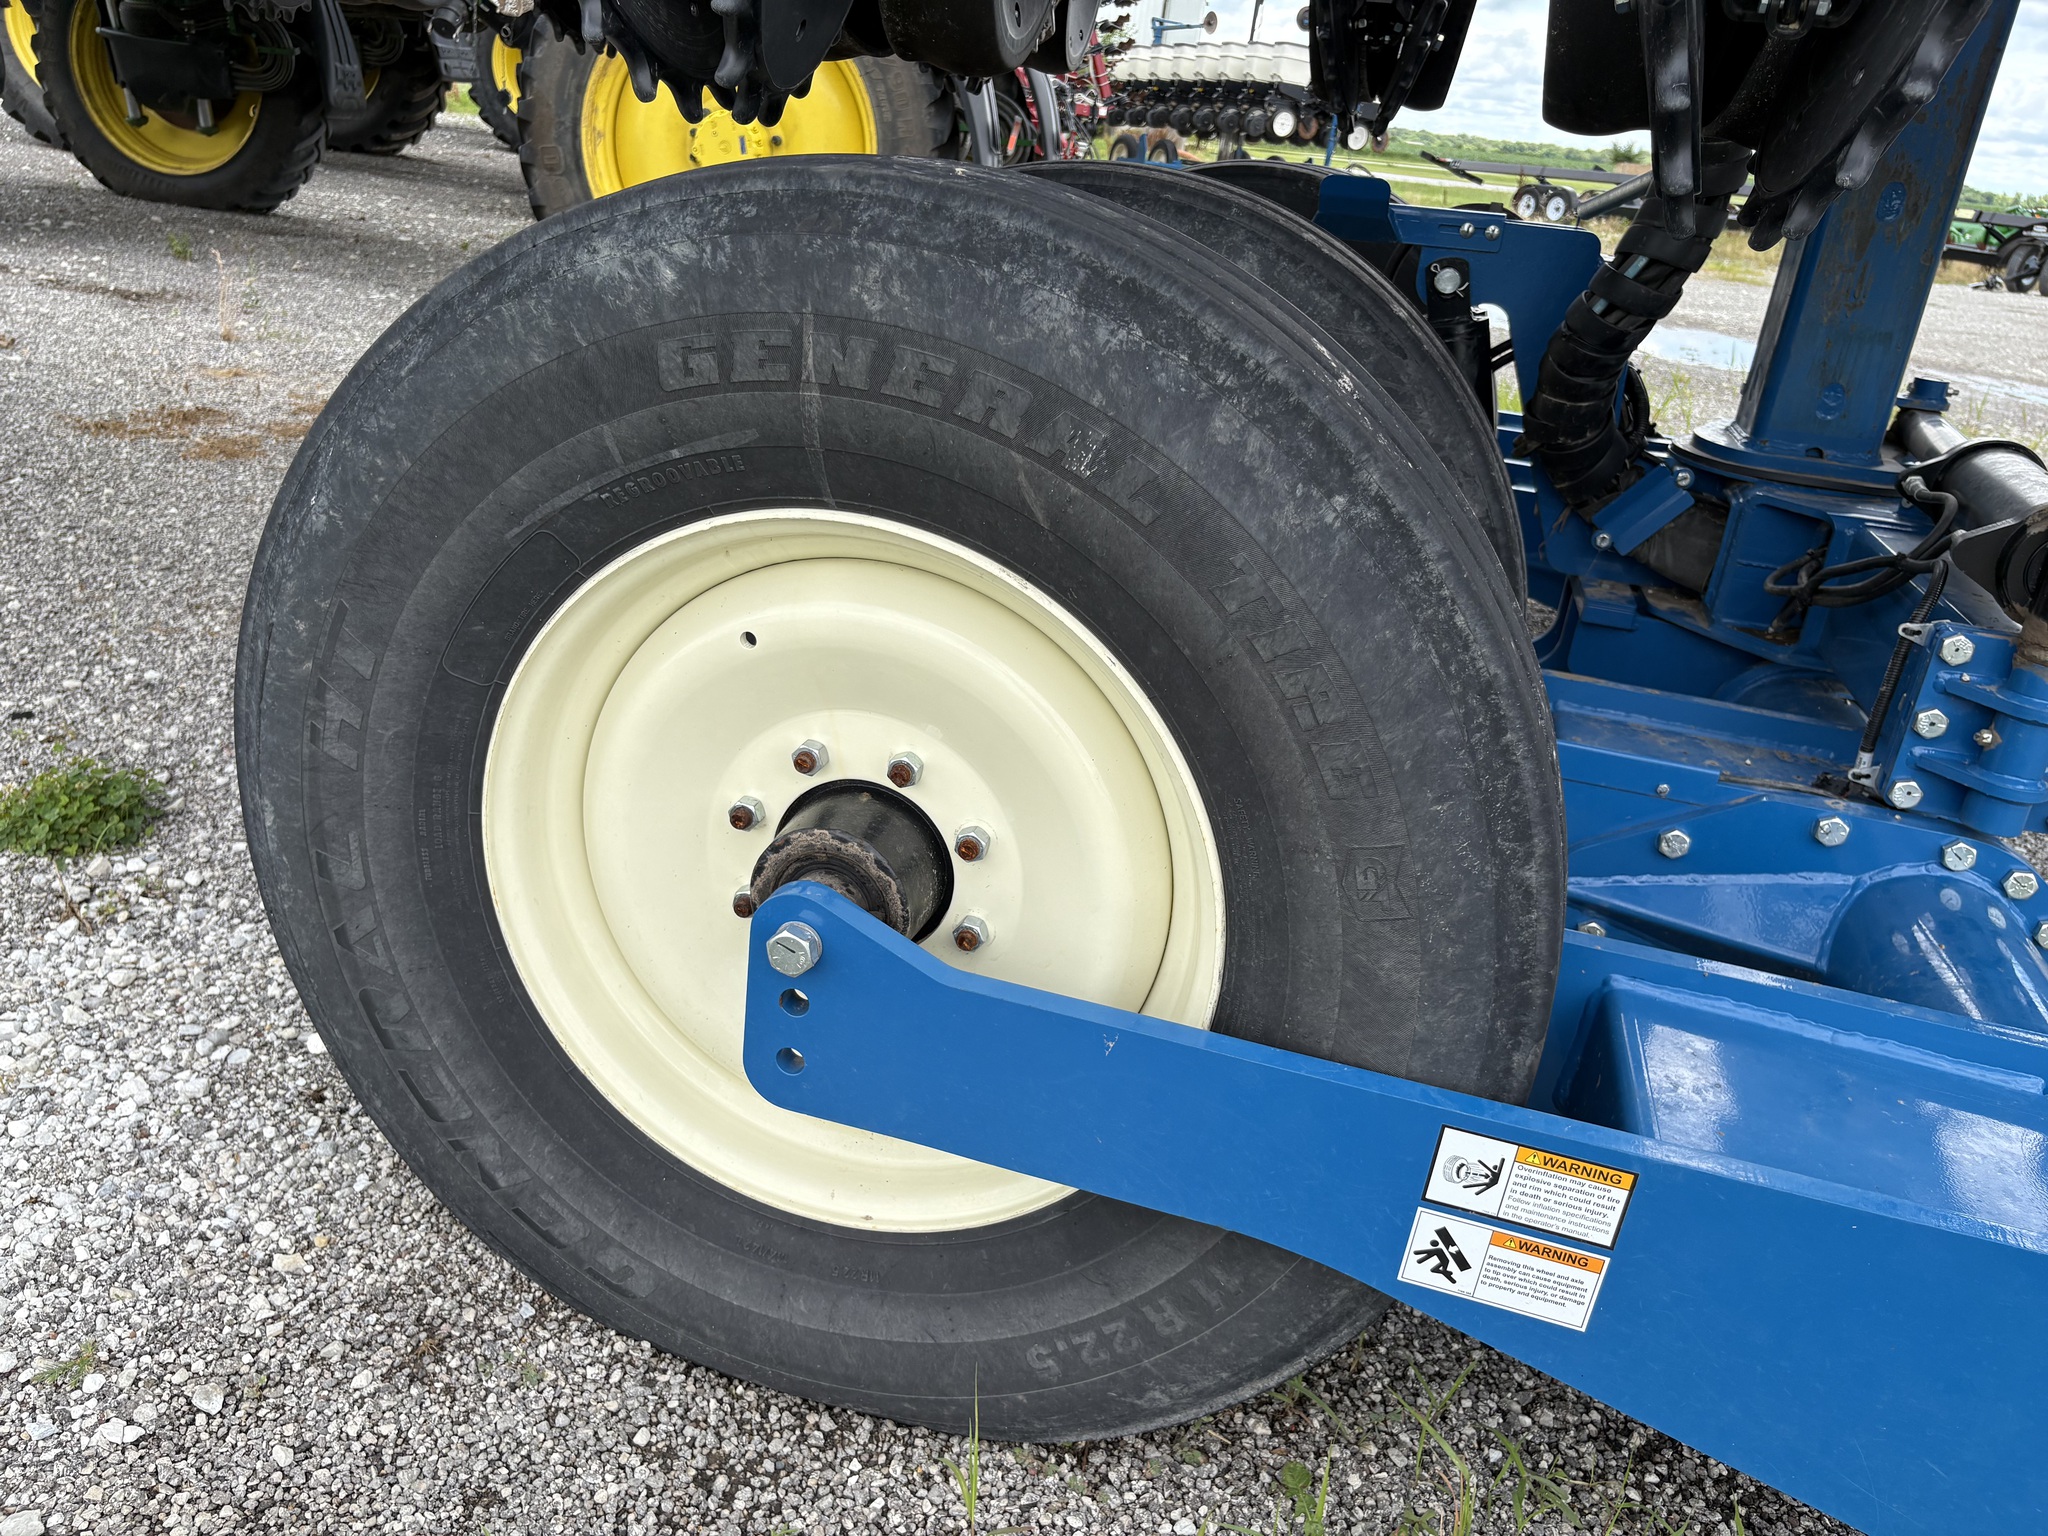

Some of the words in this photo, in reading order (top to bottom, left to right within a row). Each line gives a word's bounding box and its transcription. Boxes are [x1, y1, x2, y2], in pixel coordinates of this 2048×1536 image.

[655, 330, 1174, 529] GENERAL
[1208, 549, 1377, 801] TIRE
[314, 828, 660, 1306] GENERAL
[1517, 1165, 1567, 1182] Overinflation
[1569, 1179, 1586, 1187] may
[1588, 1184, 1611, 1193] cause
[1543, 1156, 1622, 1184] WARNING
[1515, 1174, 1551, 1186] explosive
[1553, 1183, 1595, 1197] separation
[1508, 1195, 1530, 1205] Follow
[1532, 1202, 1560, 1213] inflation
[1562, 1210, 1611, 1227] specifications
[1520, 1191, 1541, 1200] death
[1553, 1200, 1582, 1211] serious
[1585, 1207, 1608, 1218] injury.
[1544, 1189, 1567, 1198] which
[1569, 1196, 1591, 1205] could
[1593, 1202, 1616, 1211] result
[1520, 1208, 1566, 1223] maintenance
[1568, 1219, 1609, 1235] instructions
[1524, 1217, 1560, 1230] operator's
[1488, 1255, 1521, 1268] Removing
[1536, 1269, 1555, 1277] wheel
[1519, 1241, 1588, 1267] WARNING
[1486, 1262, 1517, 1274] assembly
[1553, 1280, 1587, 1293] equipment
[1488, 1283, 1515, 1293] property
[1518, 1277, 1537, 1285] which
[1539, 1283, 1557, 1291] could
[1559, 1289, 1577, 1297] result
[1504, 1280, 1527, 1289] serious
[1559, 1296, 1585, 1305] damage
